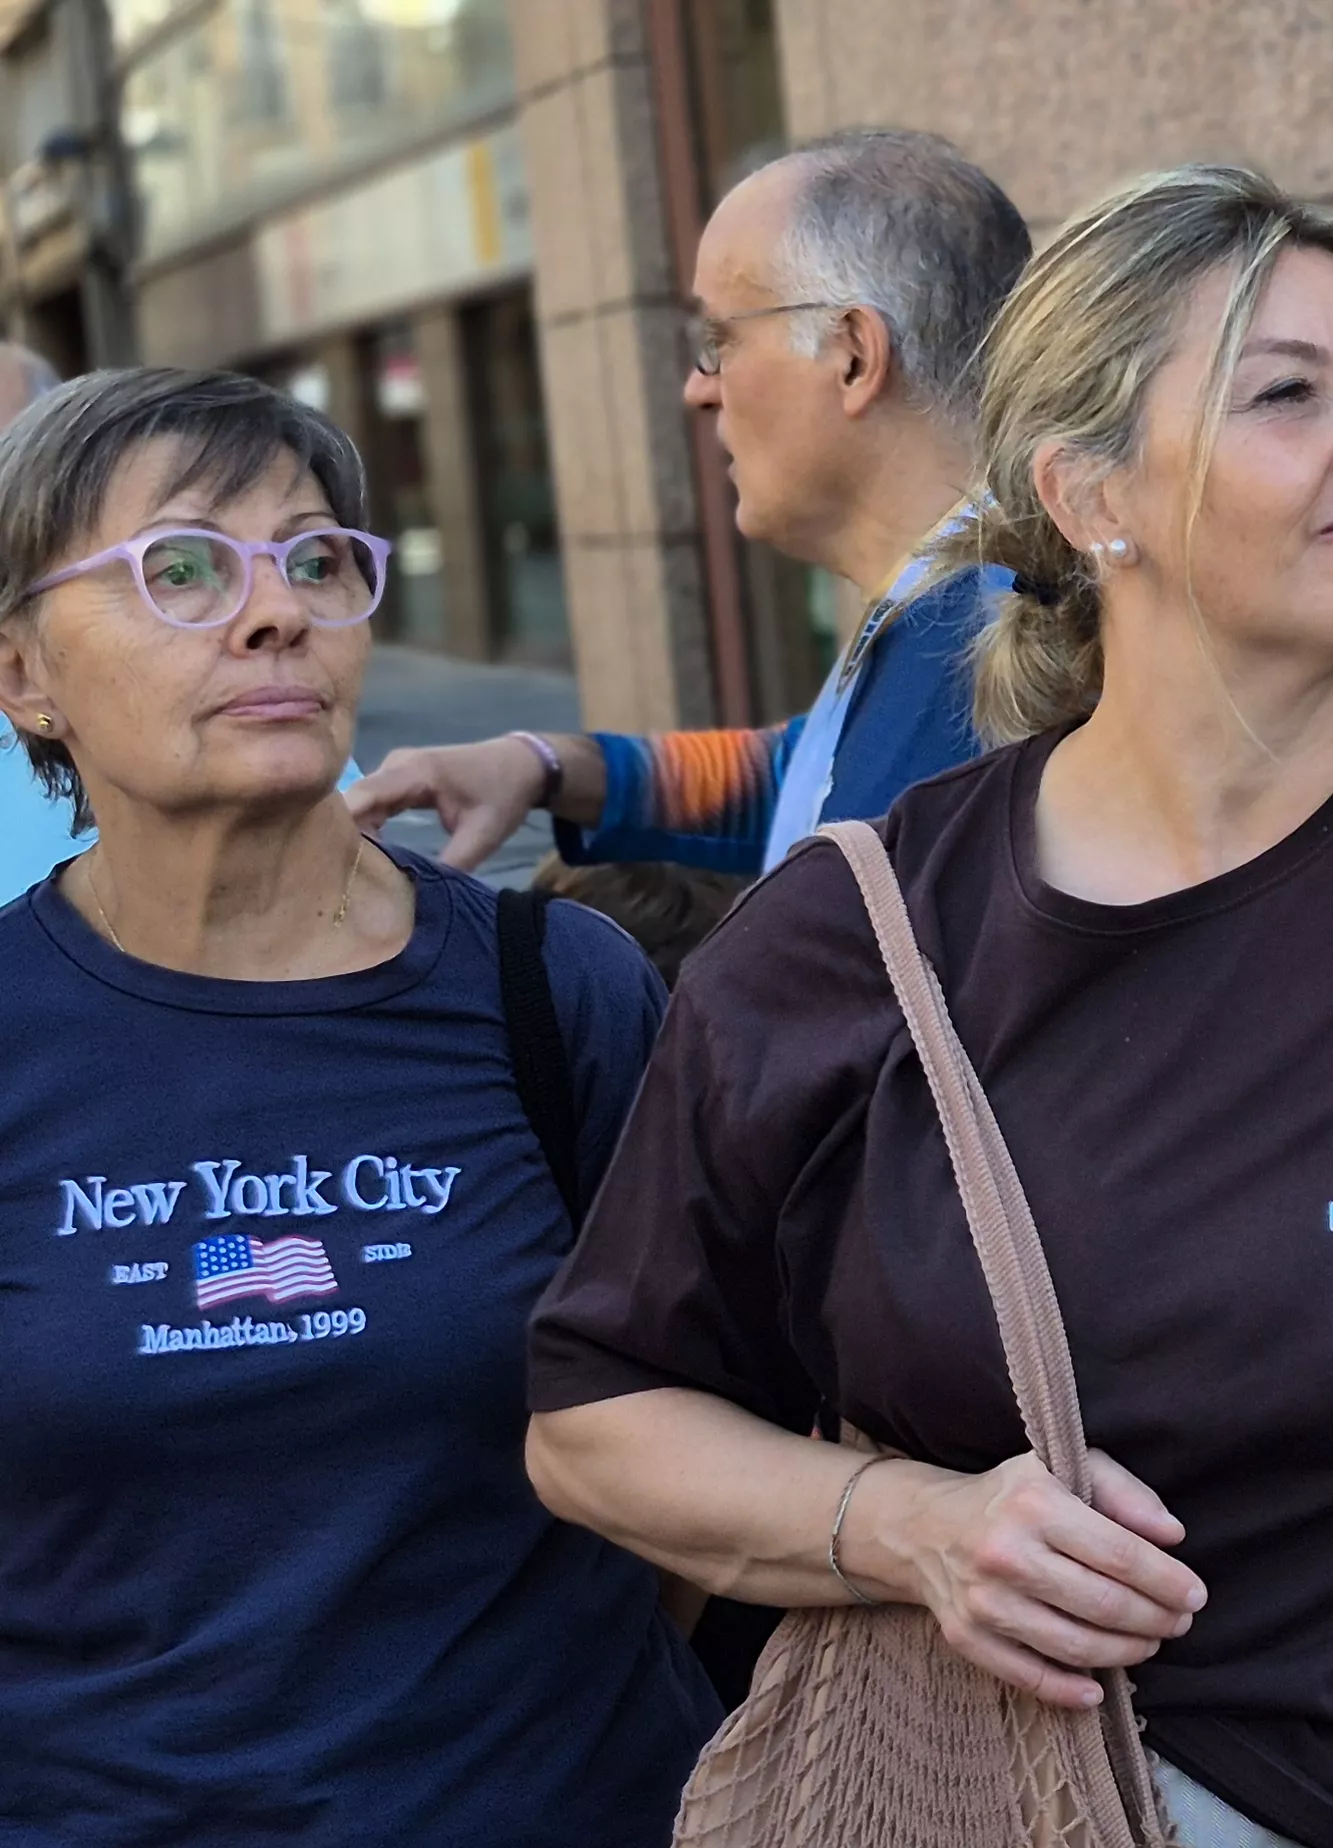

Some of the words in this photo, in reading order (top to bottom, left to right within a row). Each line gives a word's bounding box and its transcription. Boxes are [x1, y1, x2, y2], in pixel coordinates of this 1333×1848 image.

[57, 1175, 187, 1236] New
[191, 1155, 338, 1219] York
[346, 1154, 461, 1214] City
[112, 1262, 168, 1284] EAST
[362, 1242, 412, 1262] SIDE
[137, 1315, 298, 1355] Manhattan,
[301, 1306, 367, 1341] 1999
